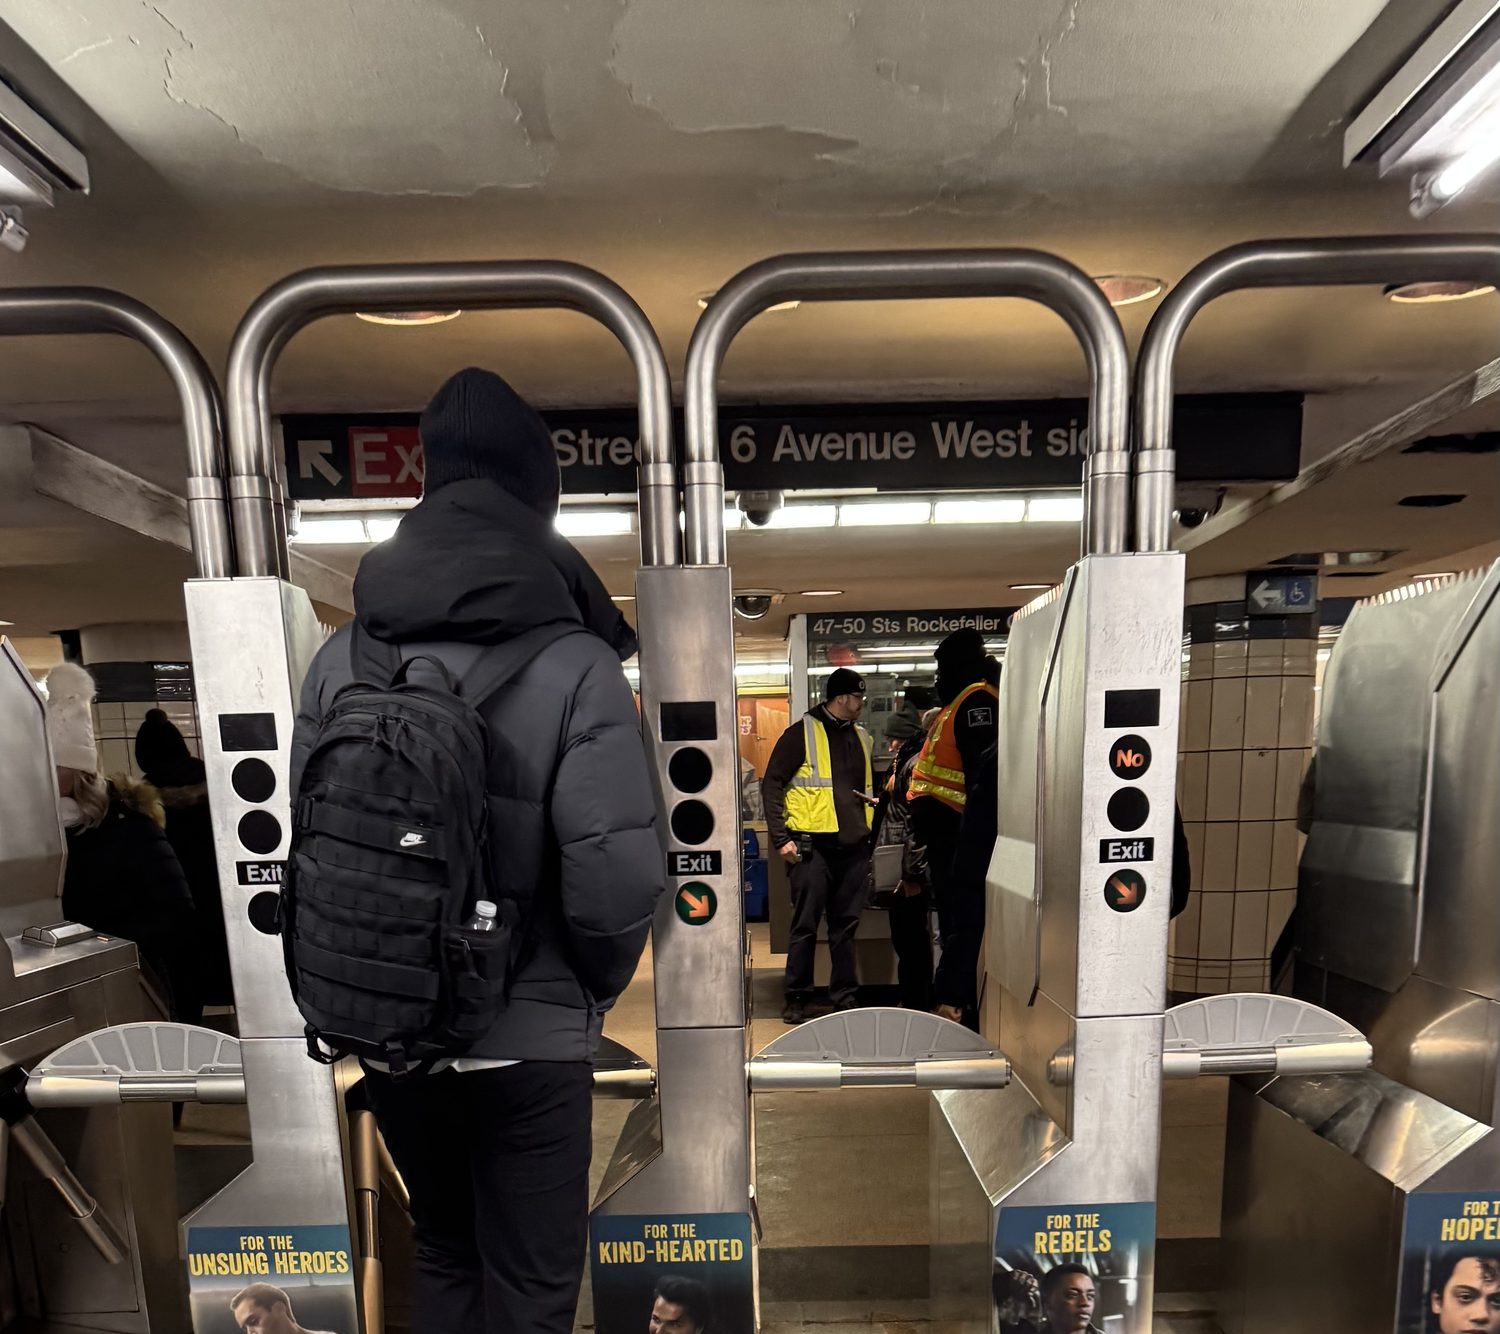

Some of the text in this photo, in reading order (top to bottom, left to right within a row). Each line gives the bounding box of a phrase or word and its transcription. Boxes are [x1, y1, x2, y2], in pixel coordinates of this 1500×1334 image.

[550, 428, 641, 467] Stre
[730, 425, 757, 463] 6
[772, 425, 916, 462] Avenue
[931, 420, 1032, 458] West
[813, 617, 865, 634] 47-50
[872, 616, 900, 633] Sts
[907, 614, 1000, 632] Rockefeller
[1116, 749, 1144, 768] No
[1108, 841, 1145, 861] Exit
[676, 854, 712, 872] Exit
[246, 864, 283, 882] Exit
[1463, 1201, 1489, 1216] FOR
[1046, 1213, 1100, 1229] FOR THE
[1441, 1217, 1500, 1241] HOPE
[644, 1224, 696, 1239] FOR THE
[240, 1235, 293, 1250] FOR THE
[599, 1239, 743, 1263] KIND-HEARTED
[1034, 1229, 1111, 1254] REBELS
[188, 1251, 349, 1276] UNSUNG HEROES
